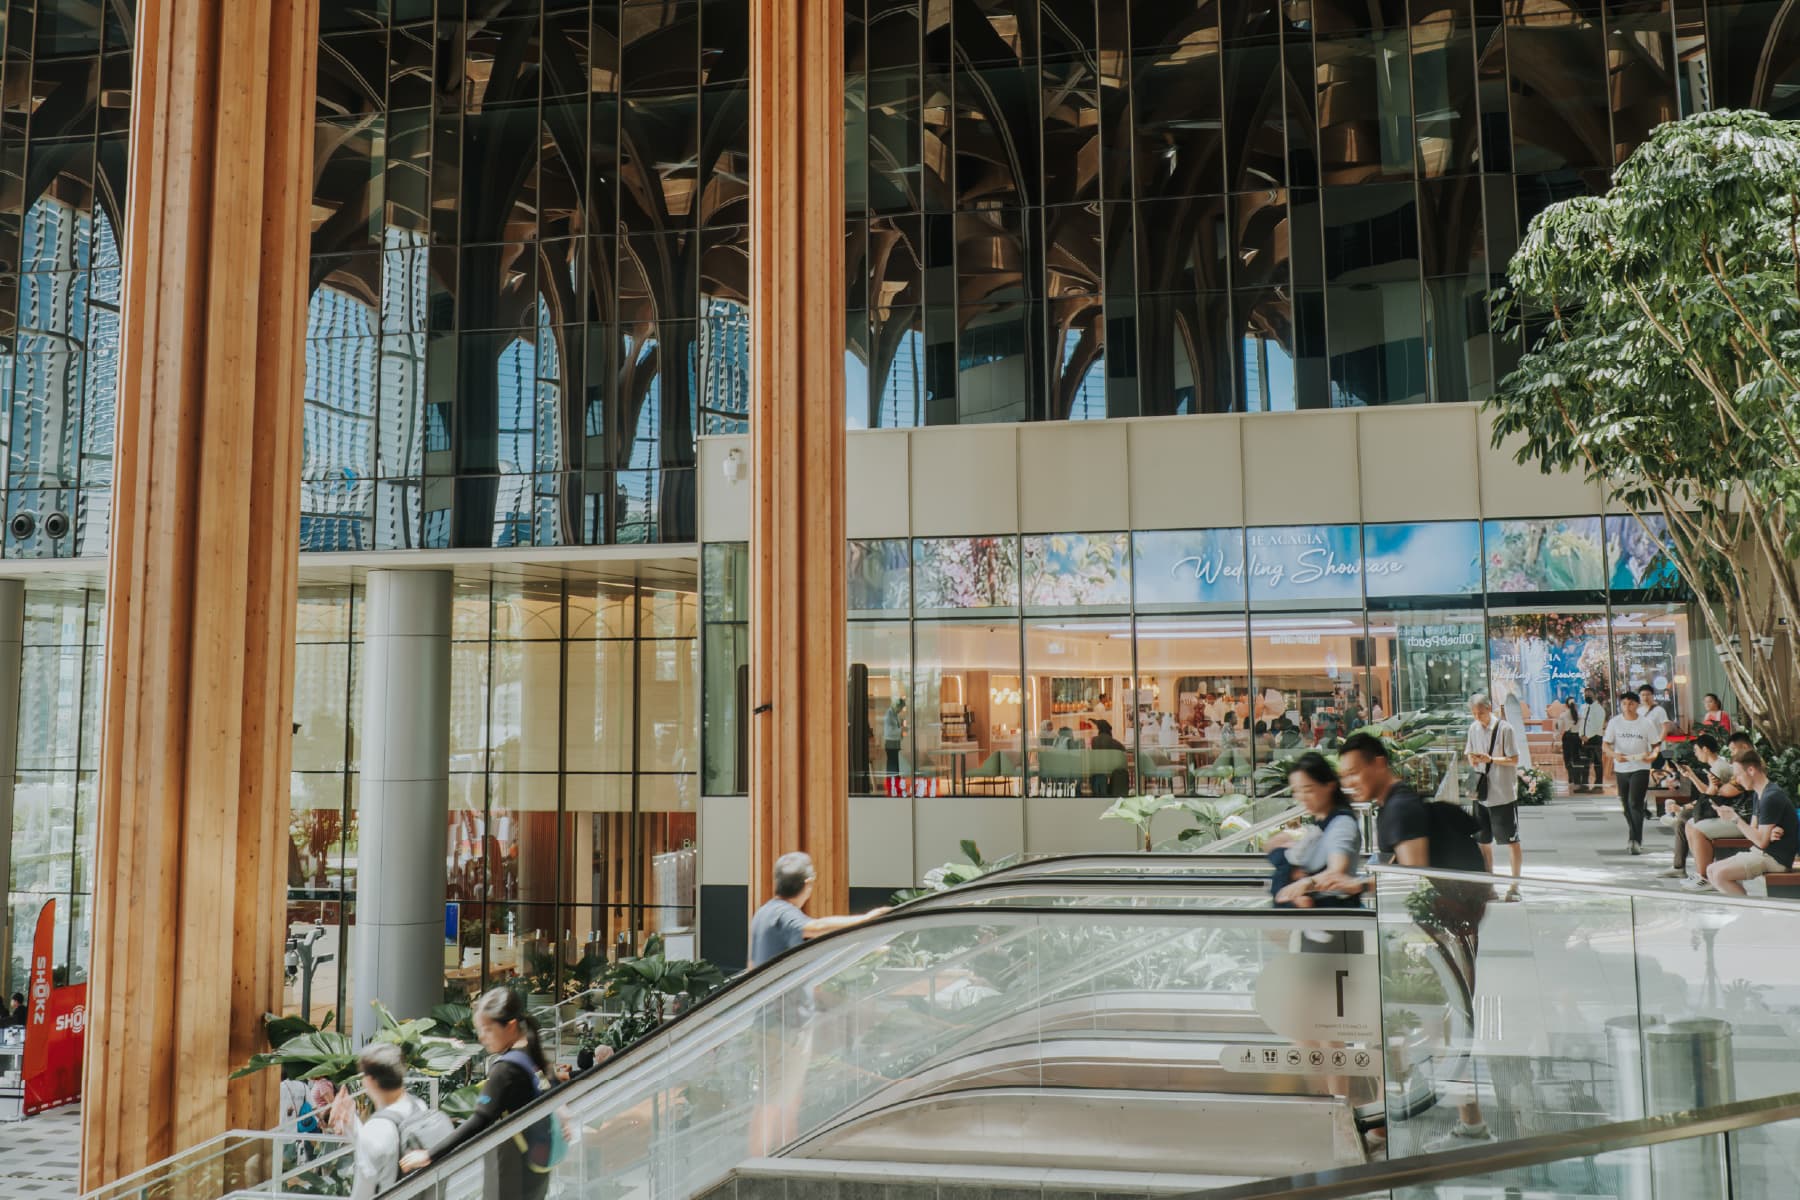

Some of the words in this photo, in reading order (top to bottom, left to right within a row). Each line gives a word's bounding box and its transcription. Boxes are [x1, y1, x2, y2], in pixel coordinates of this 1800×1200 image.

[1267, 534, 1322, 546] ACACIA
[1171, 551, 1285, 587] Wedding
[33, 956, 49, 1025] SHOKZ
